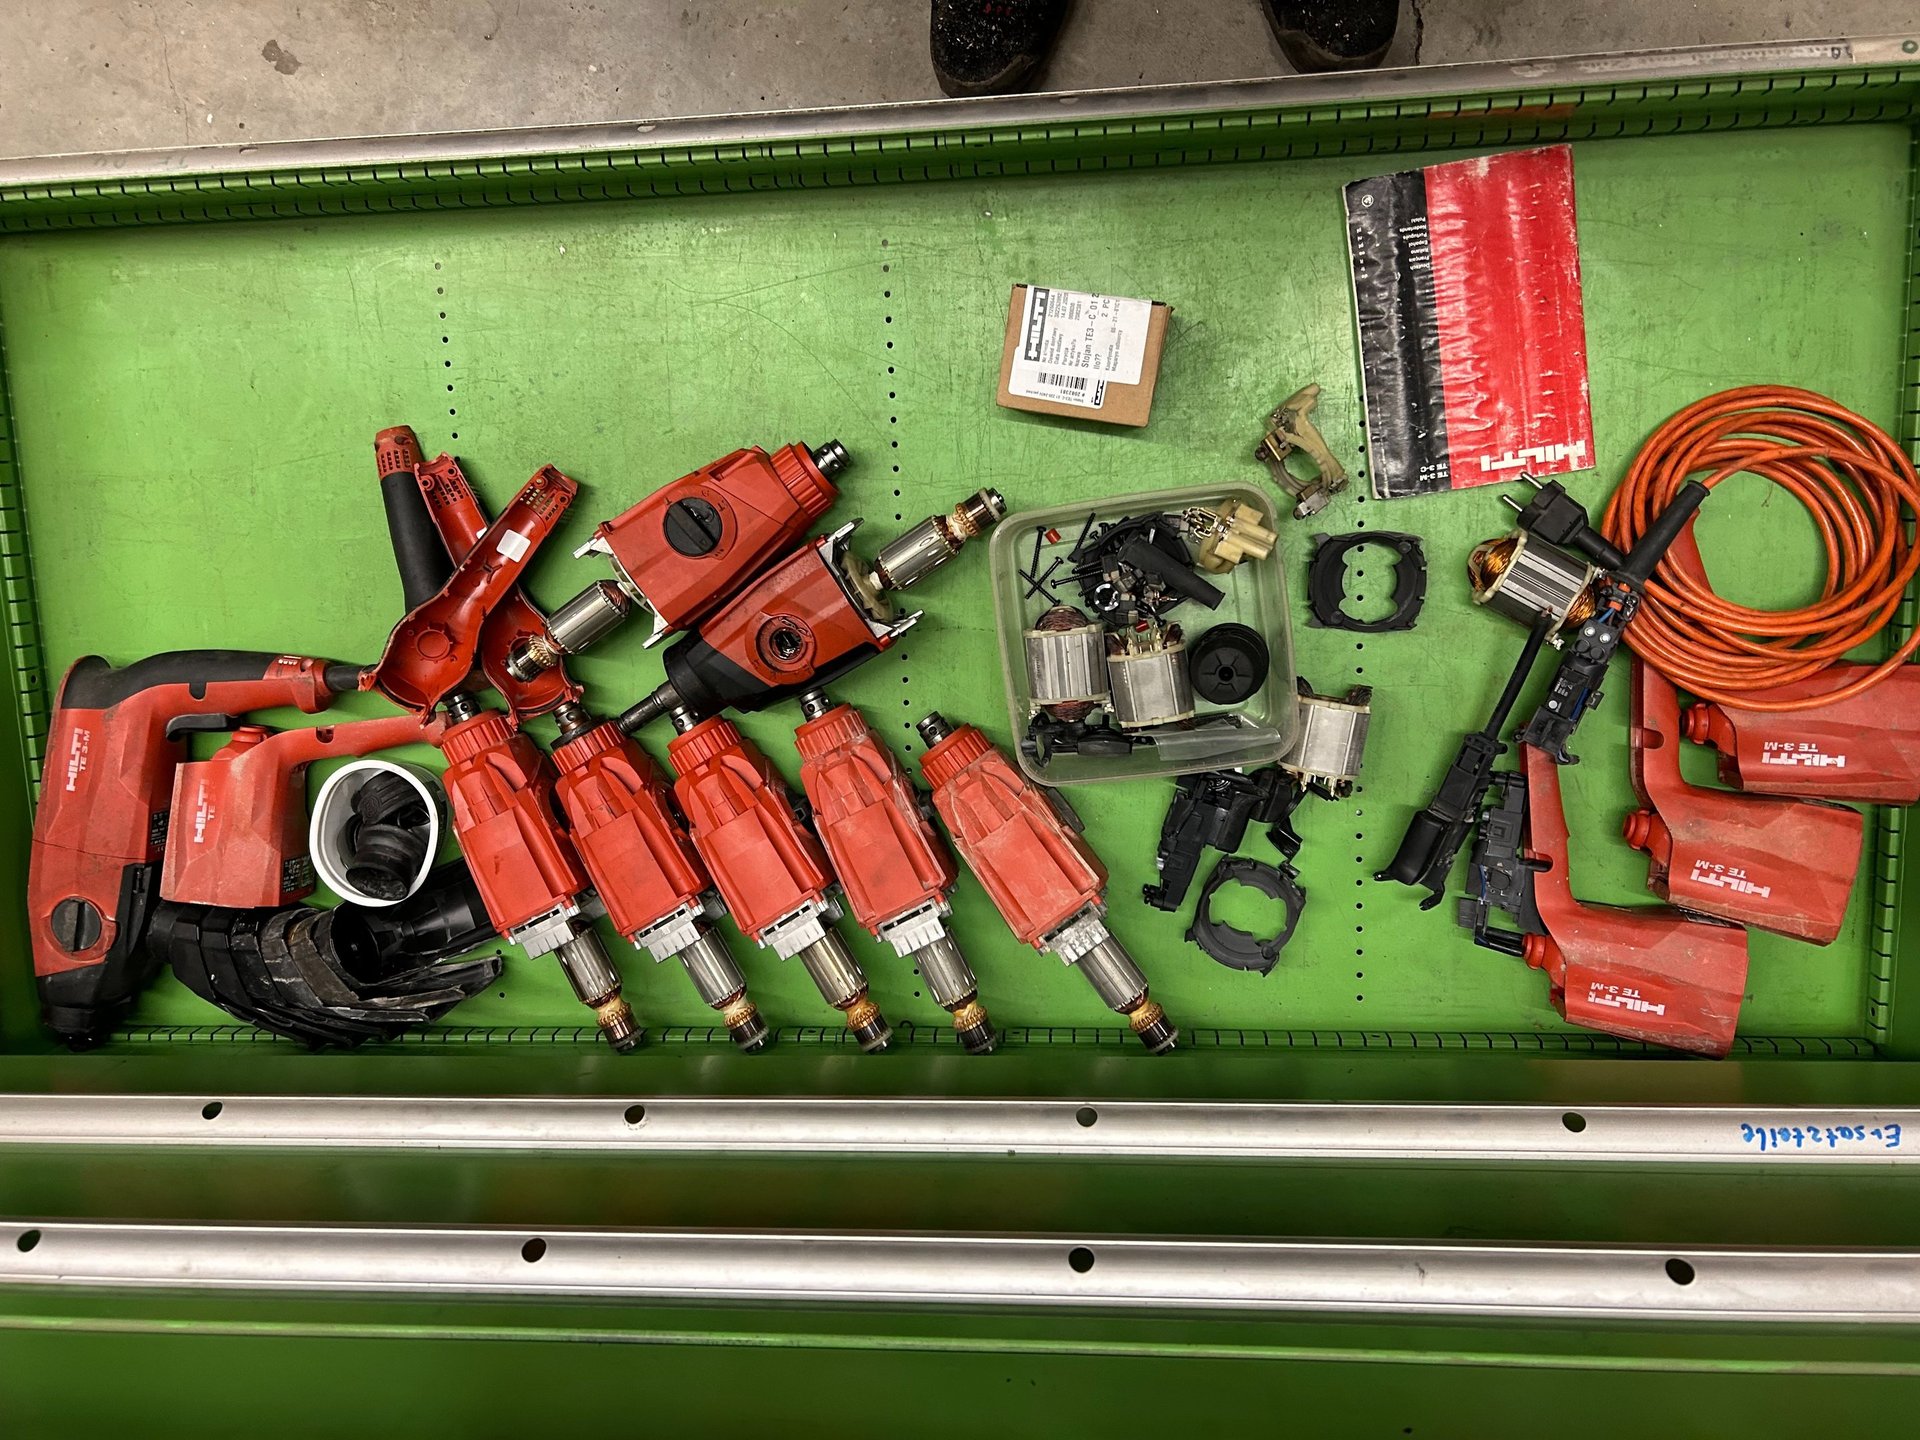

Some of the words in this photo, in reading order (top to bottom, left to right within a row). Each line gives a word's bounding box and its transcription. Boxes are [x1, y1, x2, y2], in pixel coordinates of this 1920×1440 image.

[1028, 291, 1046, 360] HILTI
[1081, 344, 1092, 367] Stojan
[1480, 440, 1585, 471] HILTI
[1420, 473, 1435, 481] 3-M
[82, 730, 91, 754] 3-M
[1764, 742, 1794, 751] 3-M
[1798, 743, 1818, 752] TE
[66, 728, 84, 792] HILTI
[79, 757, 87, 772] TE
[1762, 752, 1845, 767] HILTI
[194, 779, 210, 843] HILTI
[208, 805, 216, 820] TE
[1695, 859, 1725, 872] 3-M
[1727, 867, 1747, 879] TE
[1690, 869, 1771, 898] HILTI
[1591, 982, 1619, 994] 3-M
[1622, 988, 1641, 998] TE
[1588, 991, 1665, 1016] HILTI
[1741, 1122, 1902, 1151] Ersatzteile
